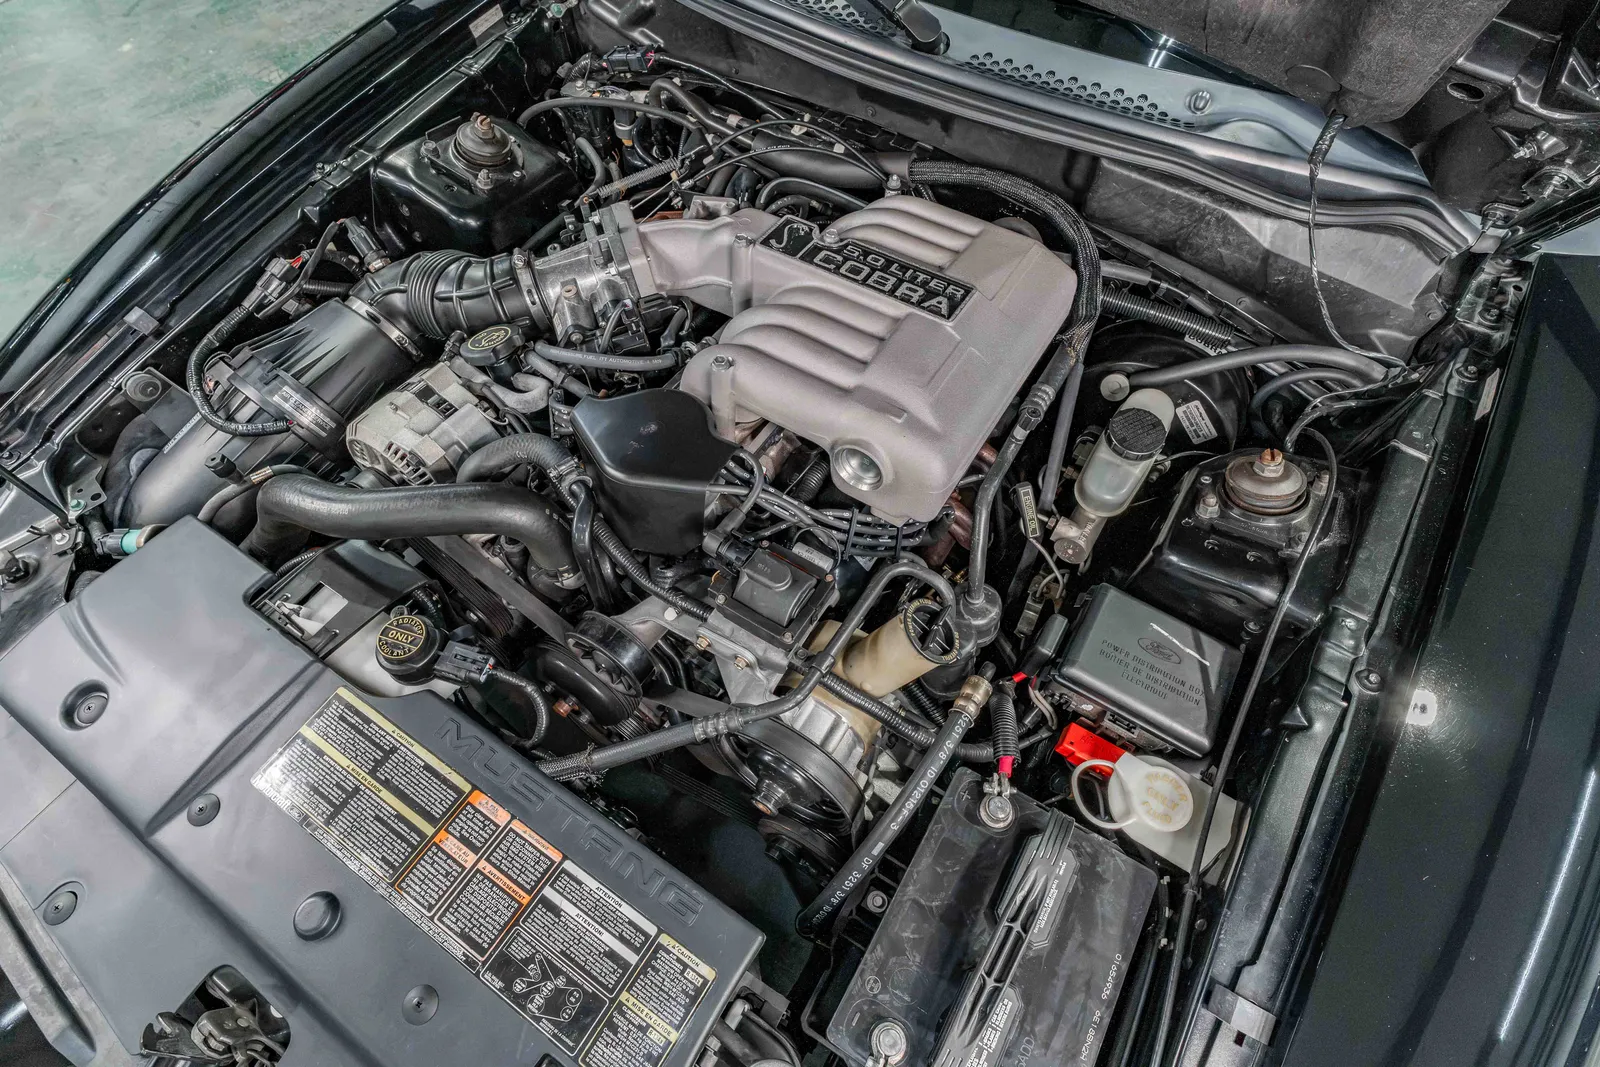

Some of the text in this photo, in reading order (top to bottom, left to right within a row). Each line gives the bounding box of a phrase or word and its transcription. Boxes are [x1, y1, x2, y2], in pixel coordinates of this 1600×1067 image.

[813, 250, 950, 319] COBRA
[843, 245, 966, 301] 5.0 LITER
[1023, 495, 1037, 531] ENGINE OIL
[388, 630, 415, 644] ONLY
[392, 617, 423, 635] RADIATOR
[379, 640, 410, 656] COOLANT
[1101, 639, 1131, 657] POWER
[1132, 654, 1186, 688] DISTRIBUTION
[1132, 664, 1143, 675] DE
[1145, 672, 1201, 706] DISTRIBUTION
[395, 732, 415, 747] CAUTION
[350, 767, 361, 776] MISE
[366, 780, 382, 793] GARDE
[434, 717, 704, 927] MUSTANG
[471, 817, 485, 828] times.
[473, 811, 485, 821] clear
[511, 841, 539, 862] DISCONNECT
[537, 860, 547, 869] THE
[514, 836, 524, 845] NOT
[523, 843, 540, 857] TAMPER
[539, 855, 551, 865] WITH
[517, 851, 535, 866] SYSTEM
[861, 856, 873, 870] DF
[482, 878, 493, 888] PAS
[486, 869, 526, 901] AVERTISSEMENT
[594, 885, 623, 908] ATTENTION
[676, 948, 700, 967] CAUTION
[630, 1000, 672, 1036] MISE EN GARDE
